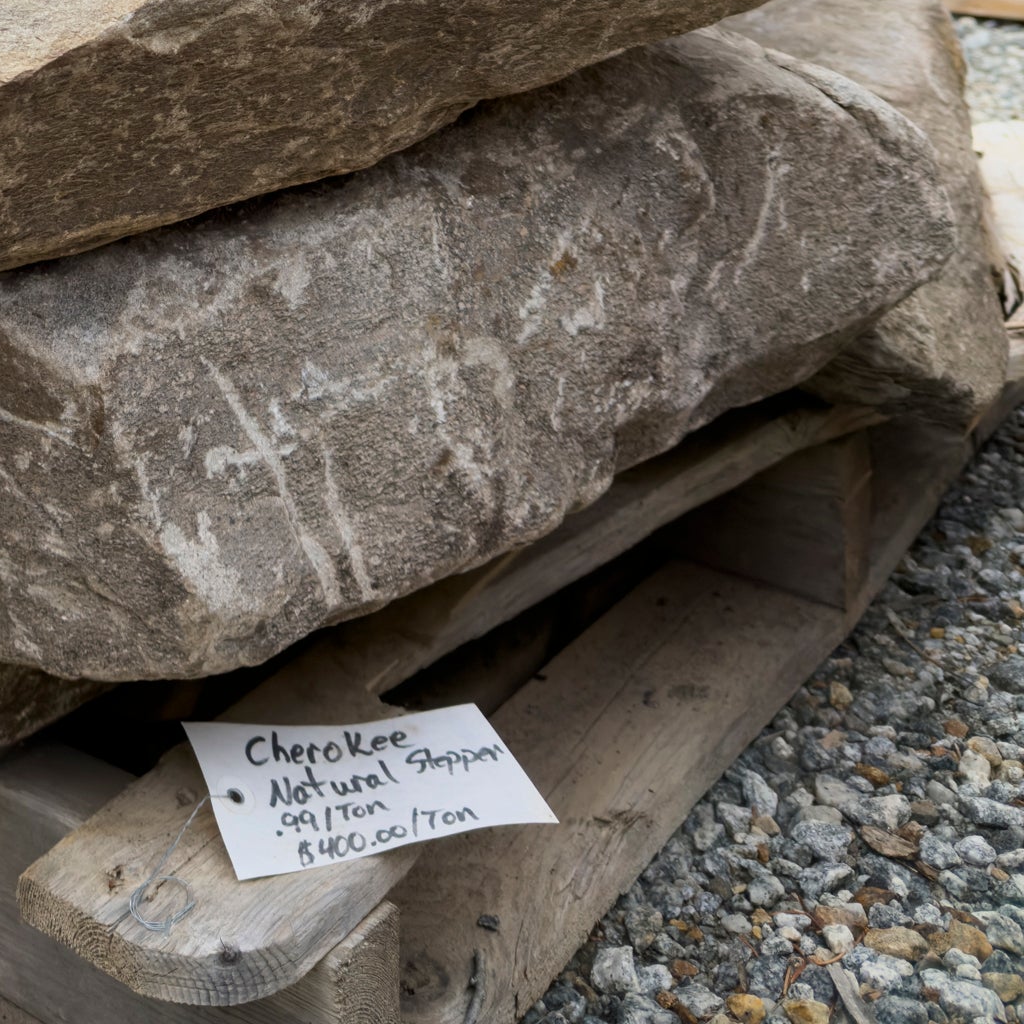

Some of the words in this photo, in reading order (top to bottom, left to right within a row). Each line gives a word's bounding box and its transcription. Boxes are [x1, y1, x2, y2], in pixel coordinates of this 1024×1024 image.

[269, 761, 400, 807] Natural
[406, 743, 504, 774] Stepper
[276, 799, 389, 836] .99/Ton
[298, 806, 479, 866] $400.00/Ton
